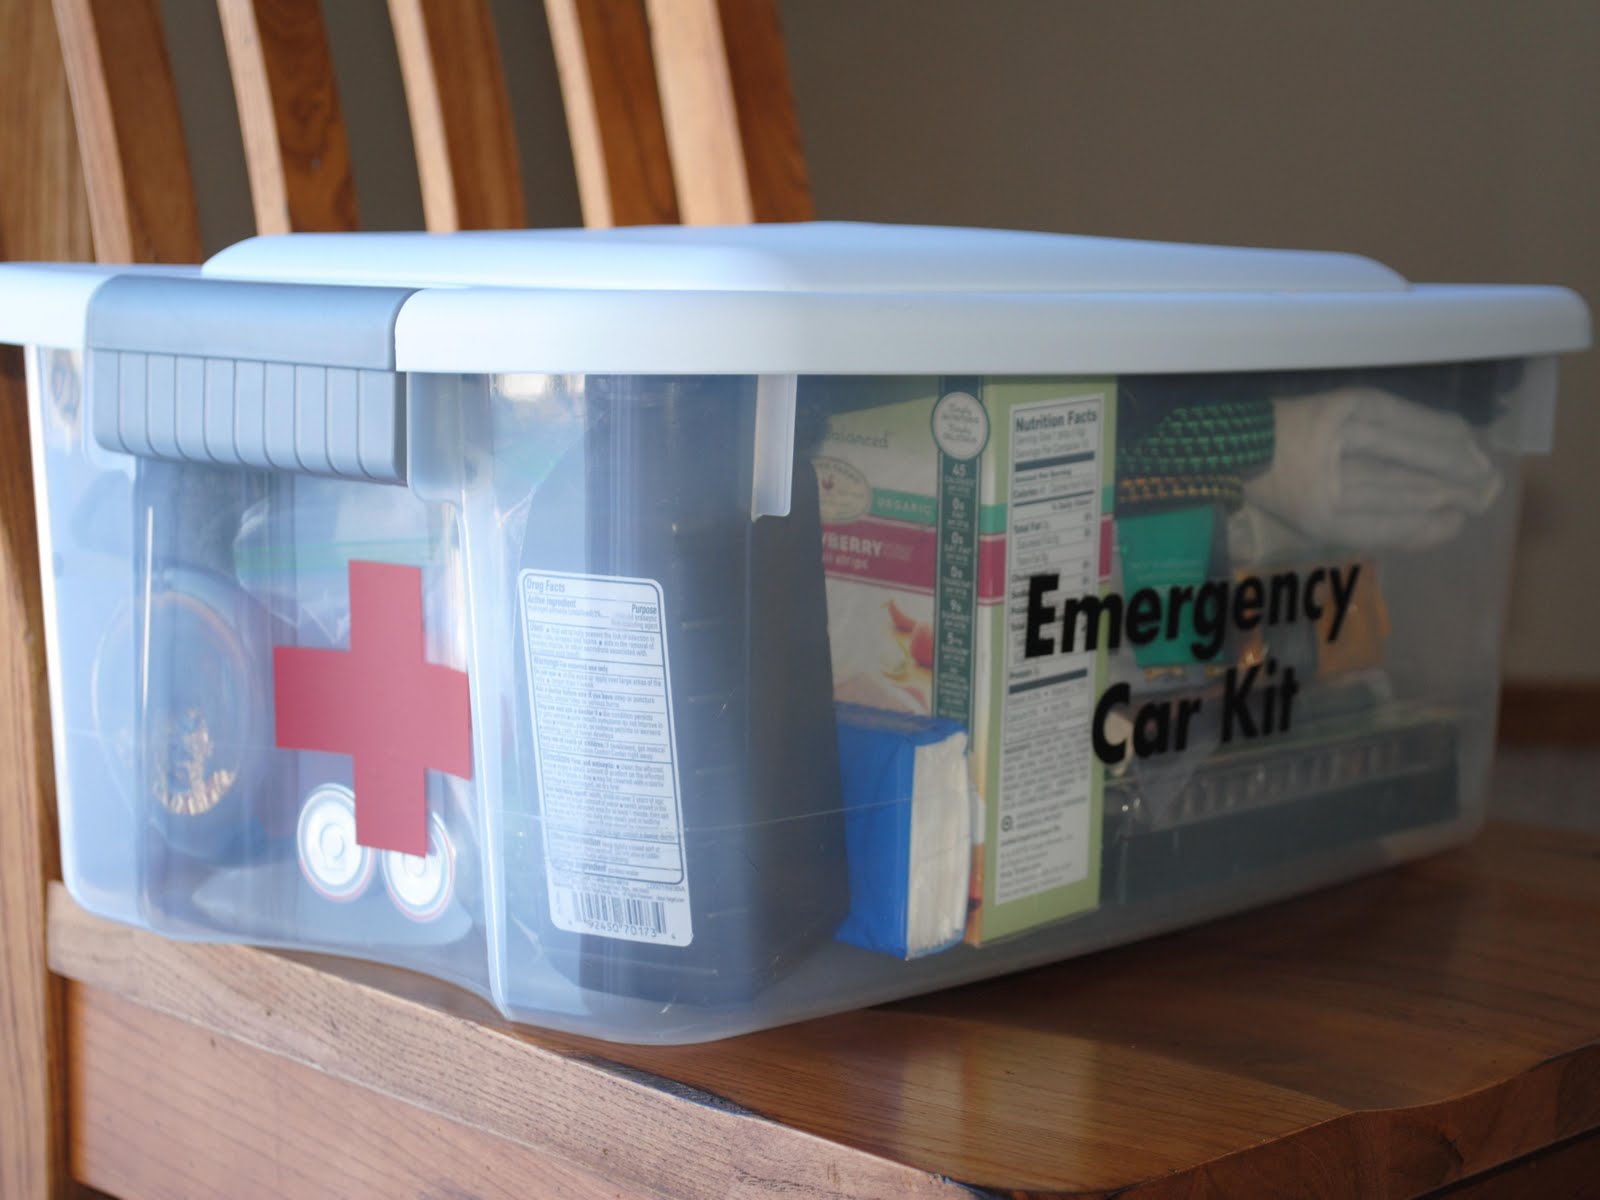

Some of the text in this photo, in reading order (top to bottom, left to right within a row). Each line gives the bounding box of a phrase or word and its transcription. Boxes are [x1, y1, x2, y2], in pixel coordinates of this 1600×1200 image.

[1016, 409, 1098, 432] Nutrition Facts
[822, 531, 883, 557] BERRY
[526, 578, 566, 593] Drug Facts
[631, 603, 658, 615] Purpose
[1024, 563, 1361, 661] Emergency
[1091, 682, 1203, 765] Car
[1220, 658, 1299, 744] Kit
